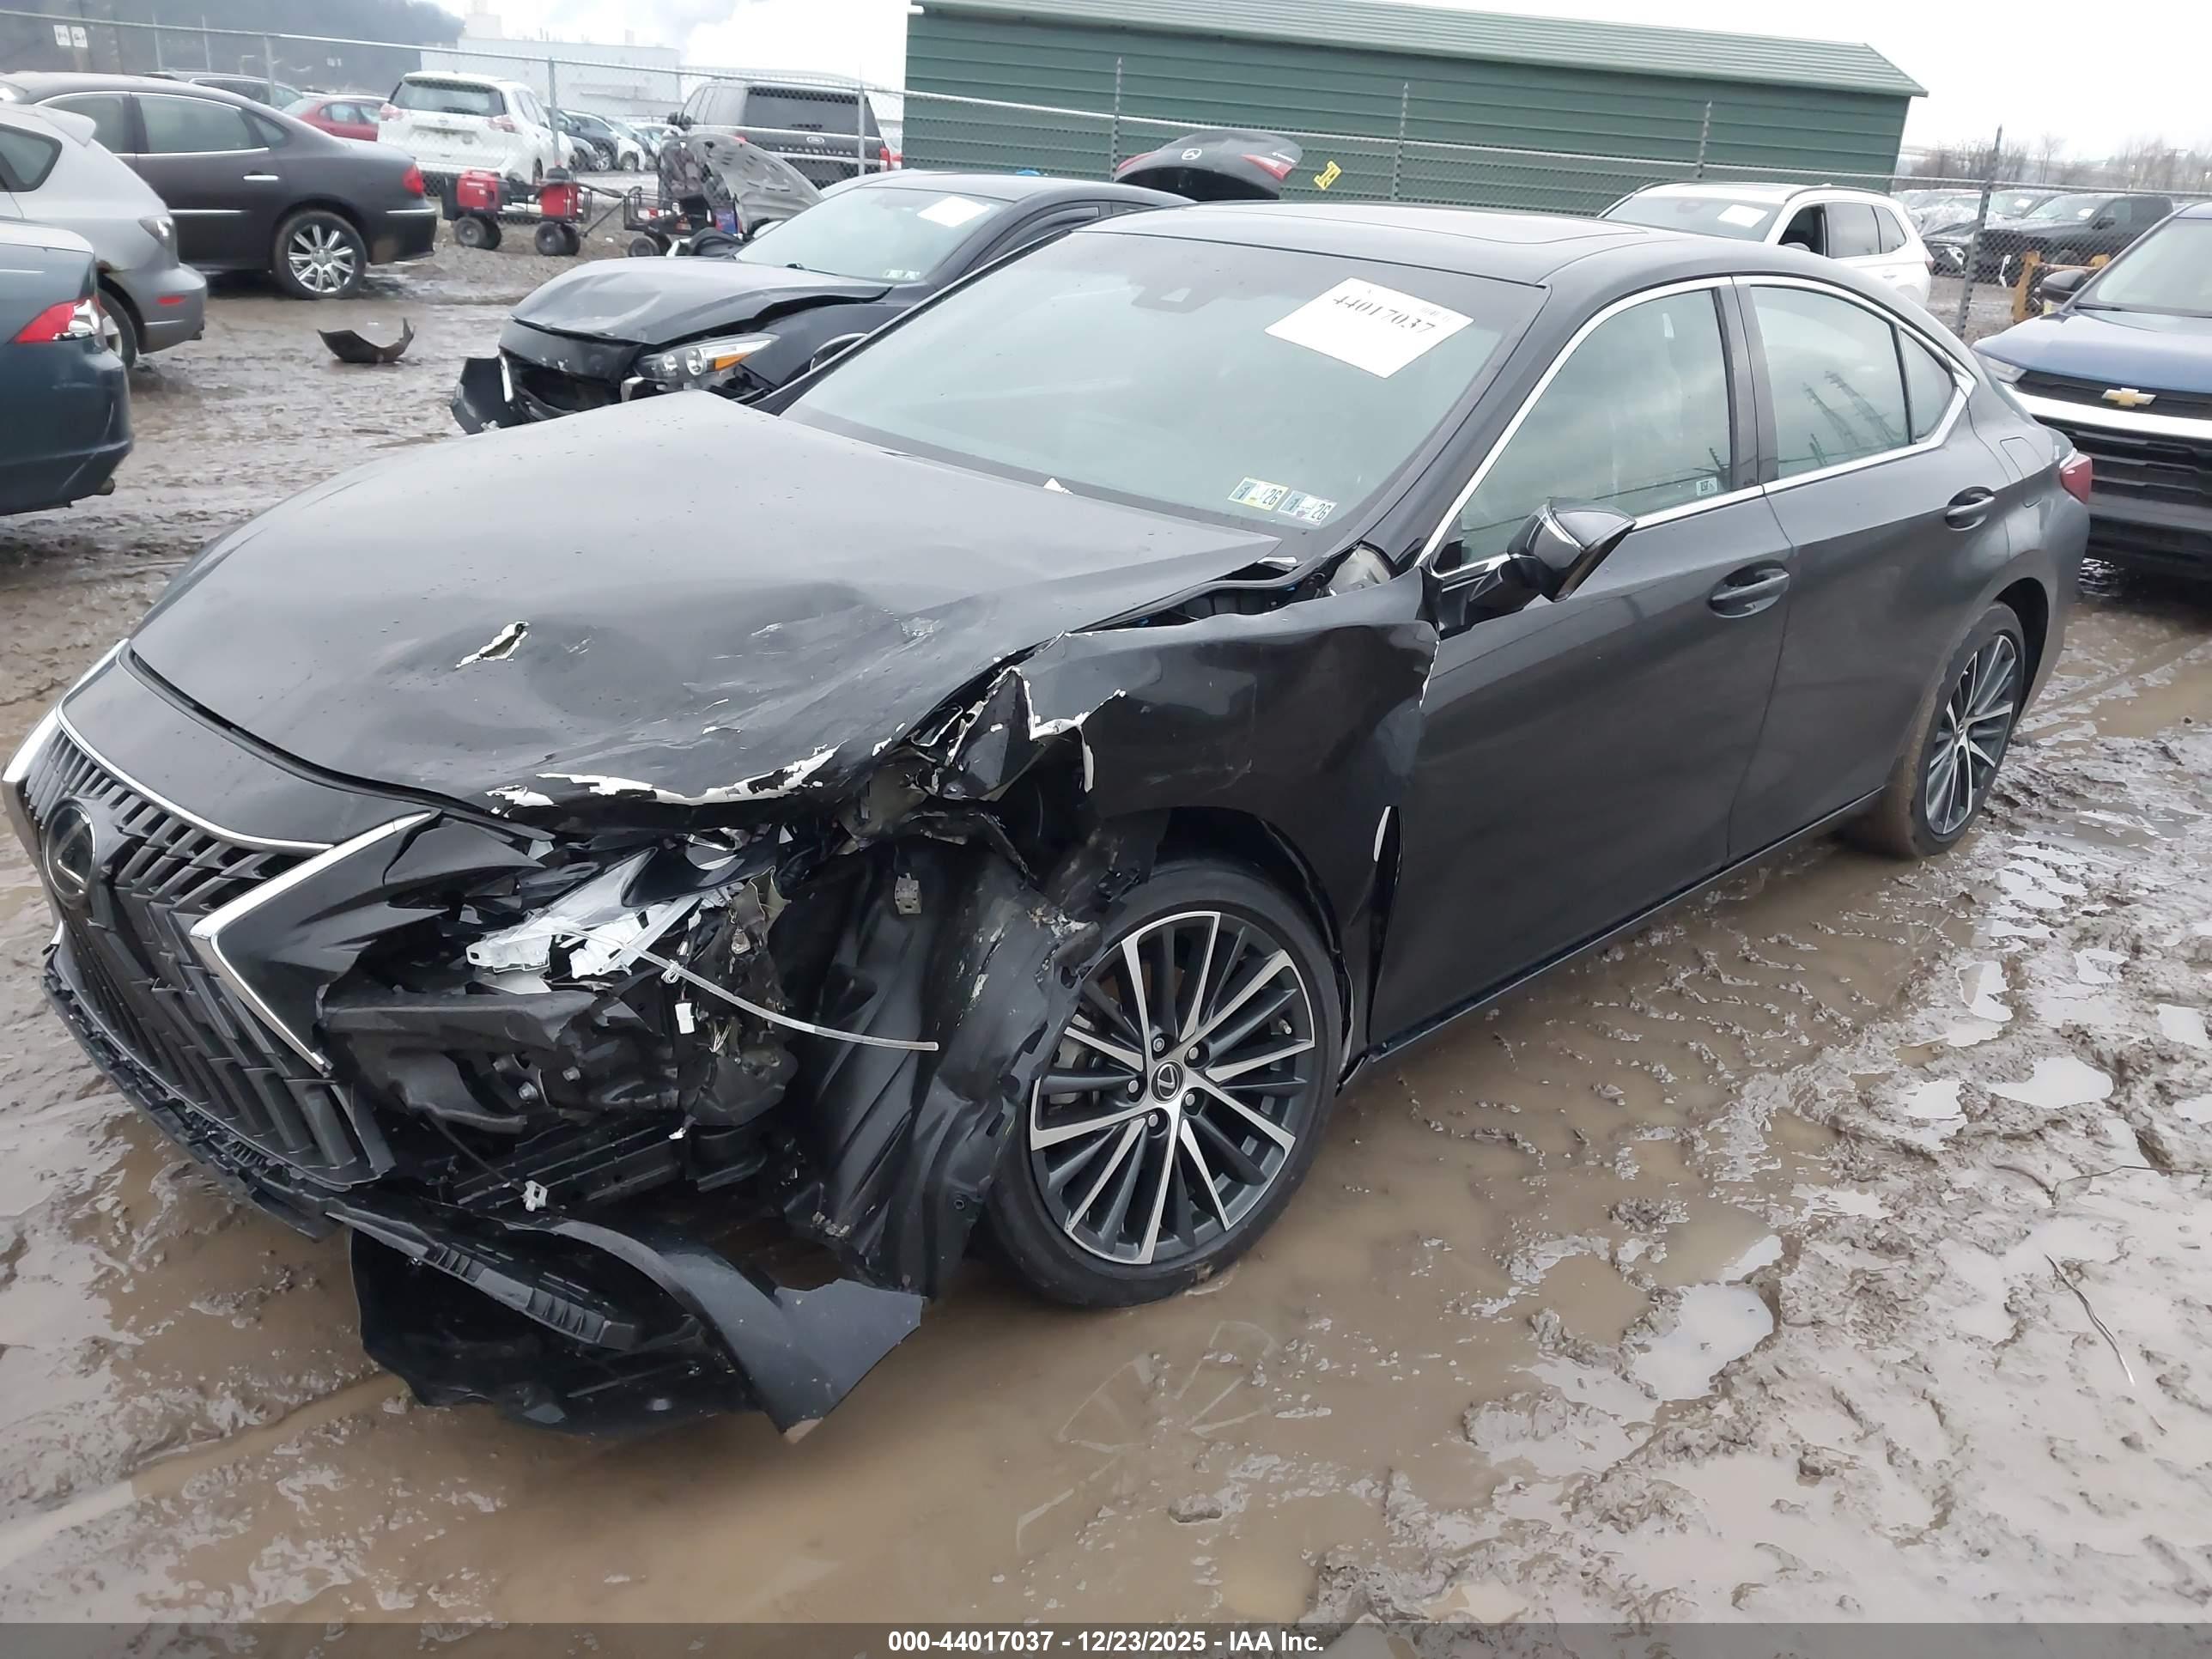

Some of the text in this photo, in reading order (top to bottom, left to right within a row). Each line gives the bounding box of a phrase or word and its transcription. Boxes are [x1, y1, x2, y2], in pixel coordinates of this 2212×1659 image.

[1333, 295, 1437, 333] 44017037
[1262, 488, 1283, 506] 26
[1311, 503, 1332, 520] 26
